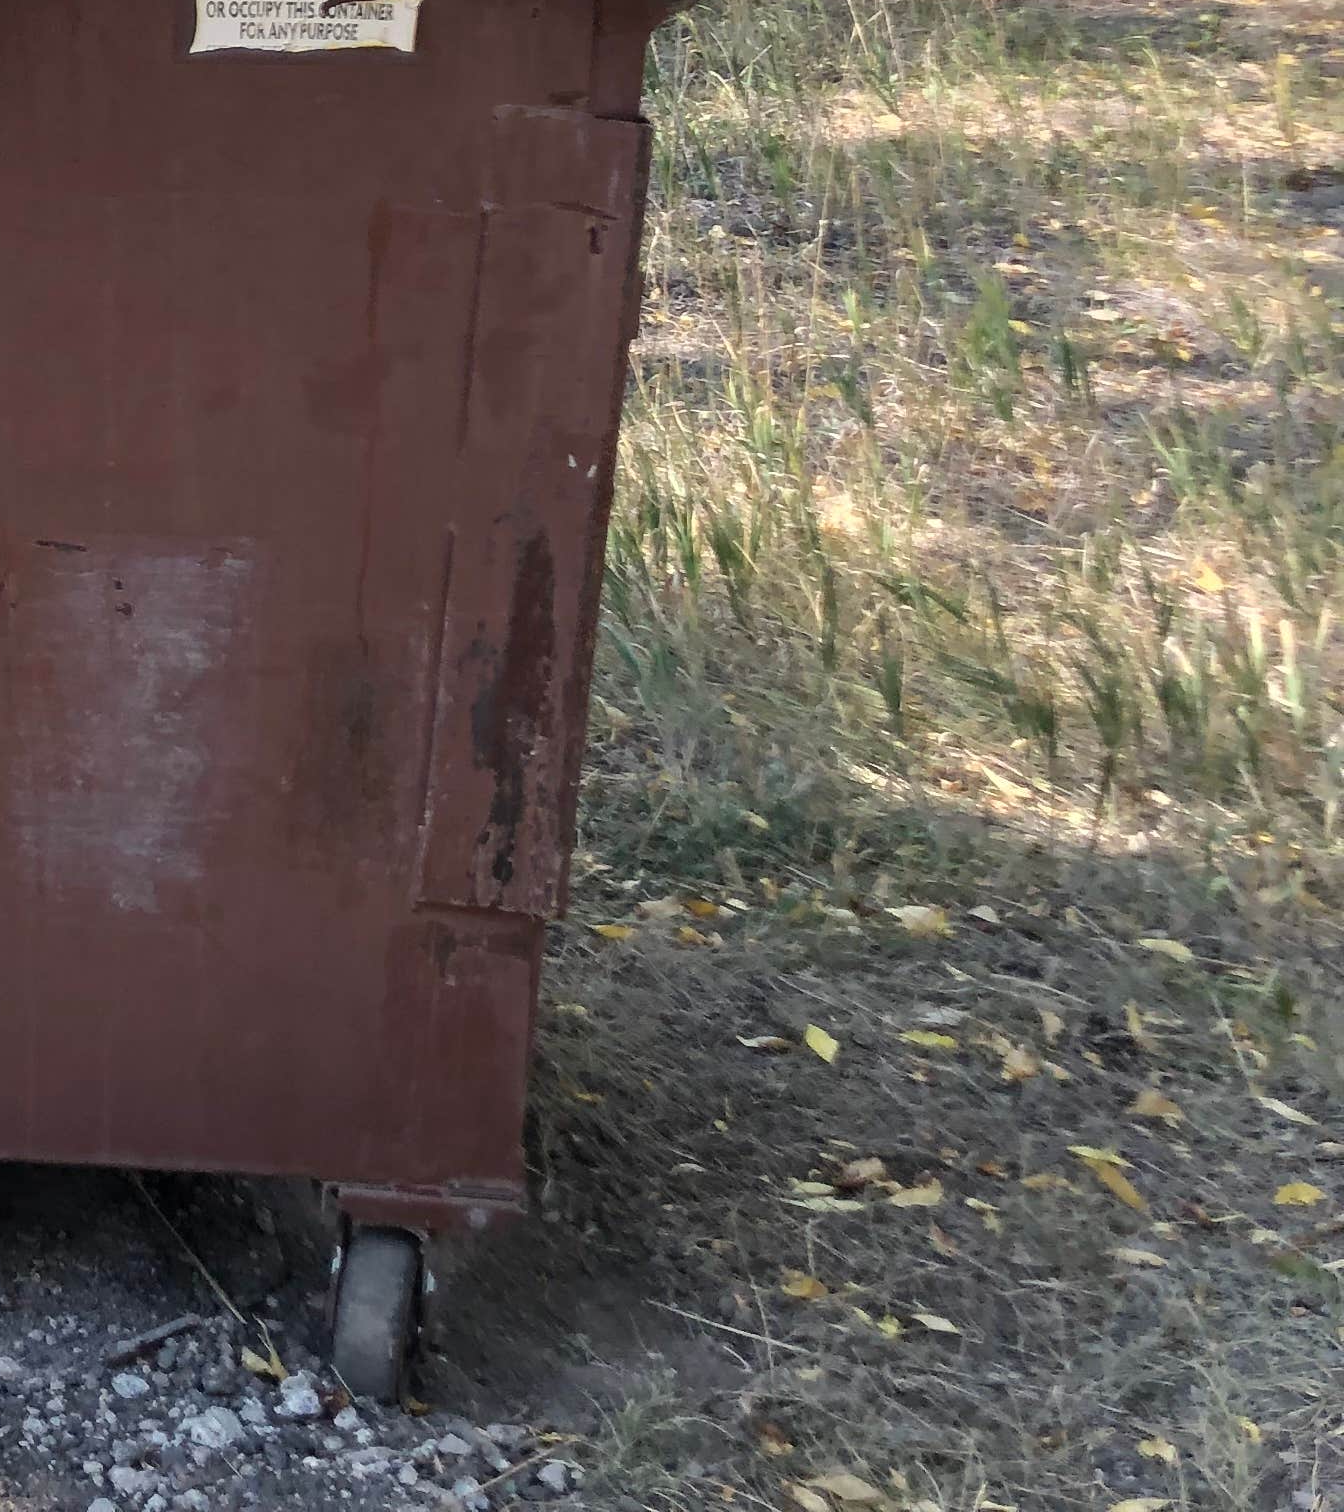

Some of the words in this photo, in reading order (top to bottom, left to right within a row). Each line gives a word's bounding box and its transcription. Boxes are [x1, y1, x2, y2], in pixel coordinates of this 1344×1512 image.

[206, 0, 226, 18] OR
[229, 1, 282, 18] OCCUPY
[285, 1, 315, 18] THIS
[239, 22, 266, 39] FOR
[268, 22, 298, 40] ANY
[299, 22, 359, 40] PURPOSE
